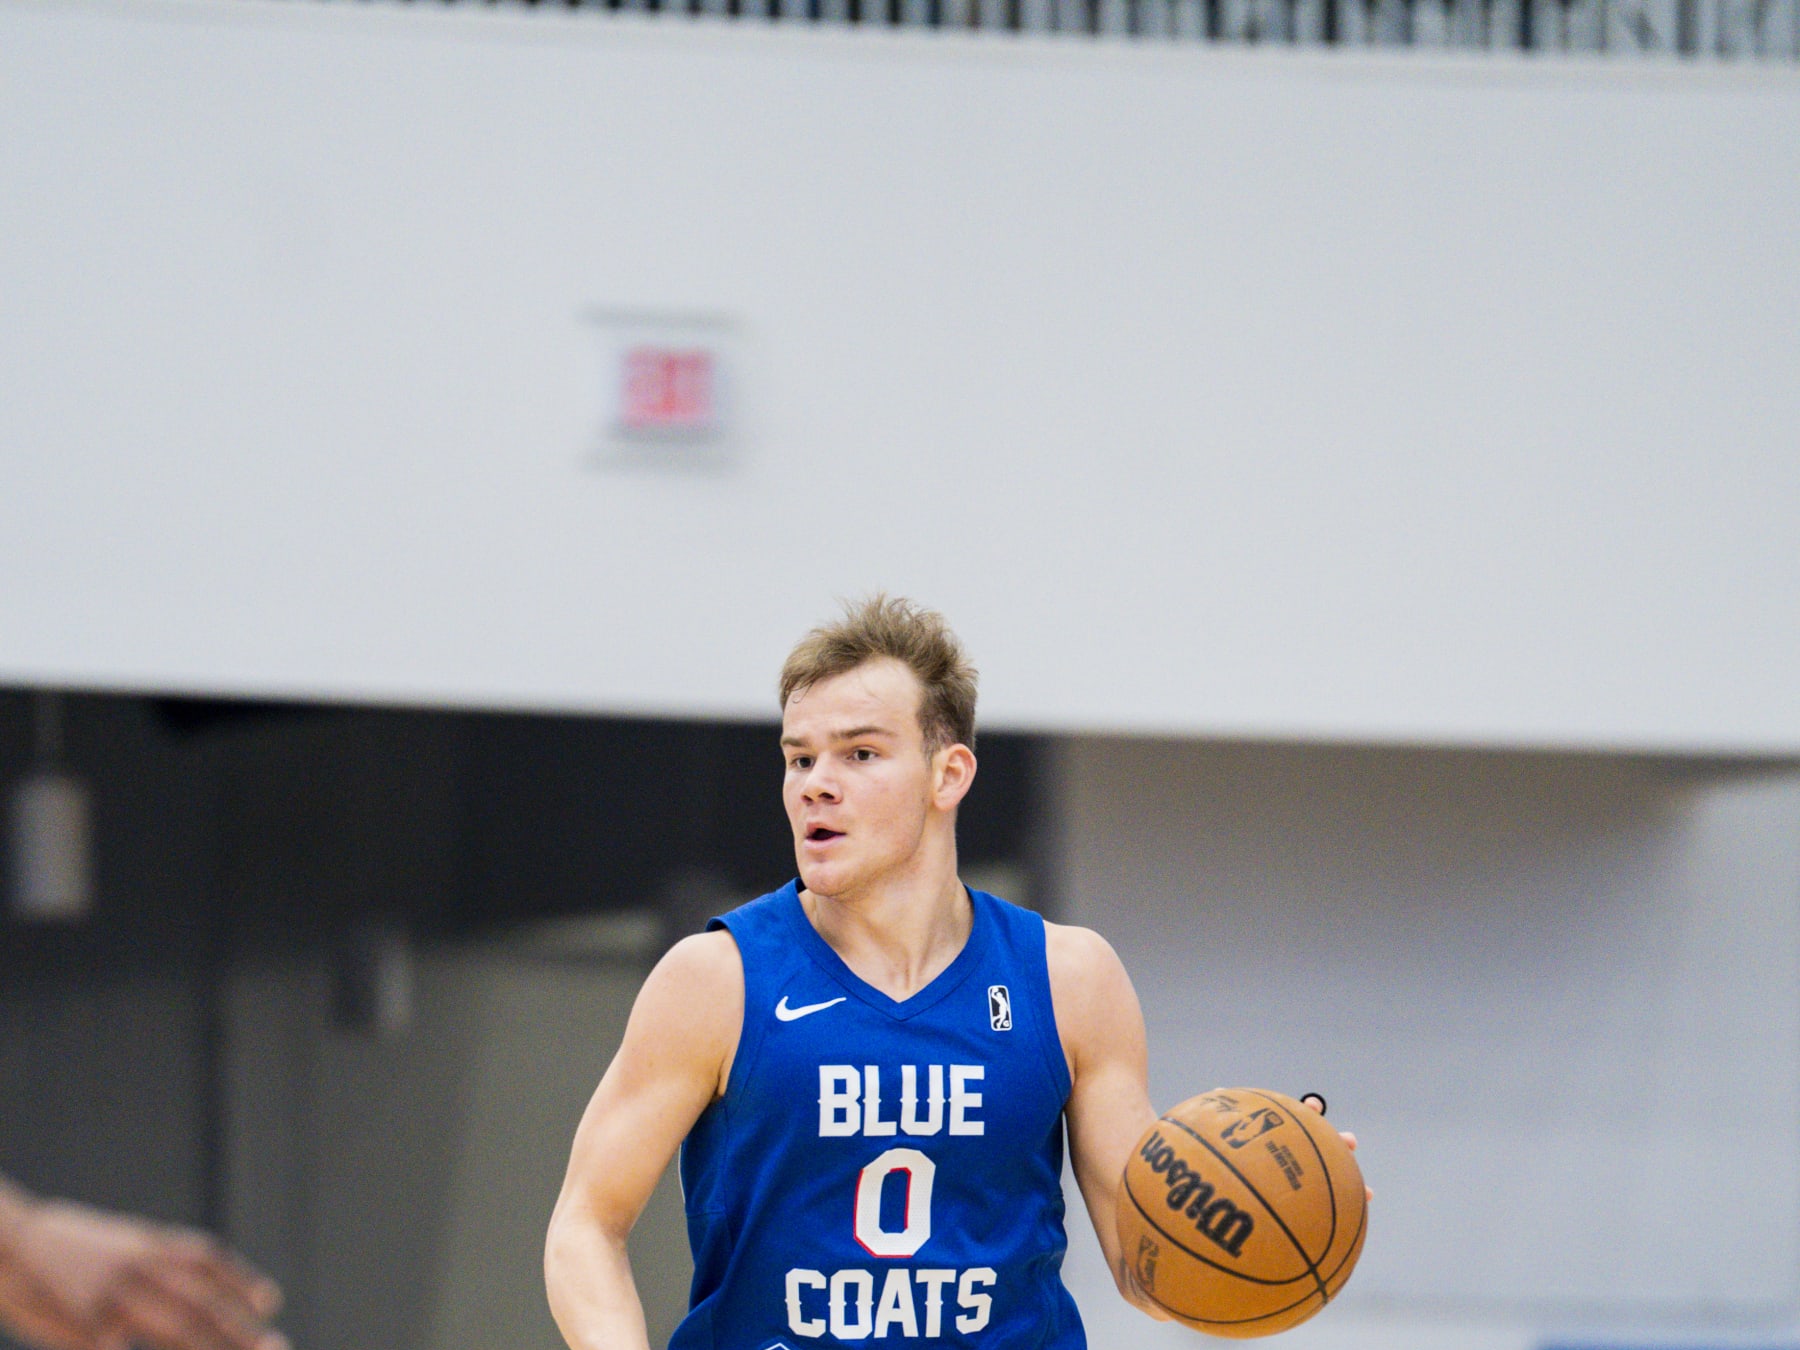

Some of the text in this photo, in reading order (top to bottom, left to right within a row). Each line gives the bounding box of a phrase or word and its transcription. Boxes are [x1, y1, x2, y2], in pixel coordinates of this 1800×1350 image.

[818, 1065, 985, 1136] BLUE
[854, 1148, 936, 1258] 0
[1139, 1130, 1255, 1259] Wilson
[785, 1268, 997, 1339] COATS
